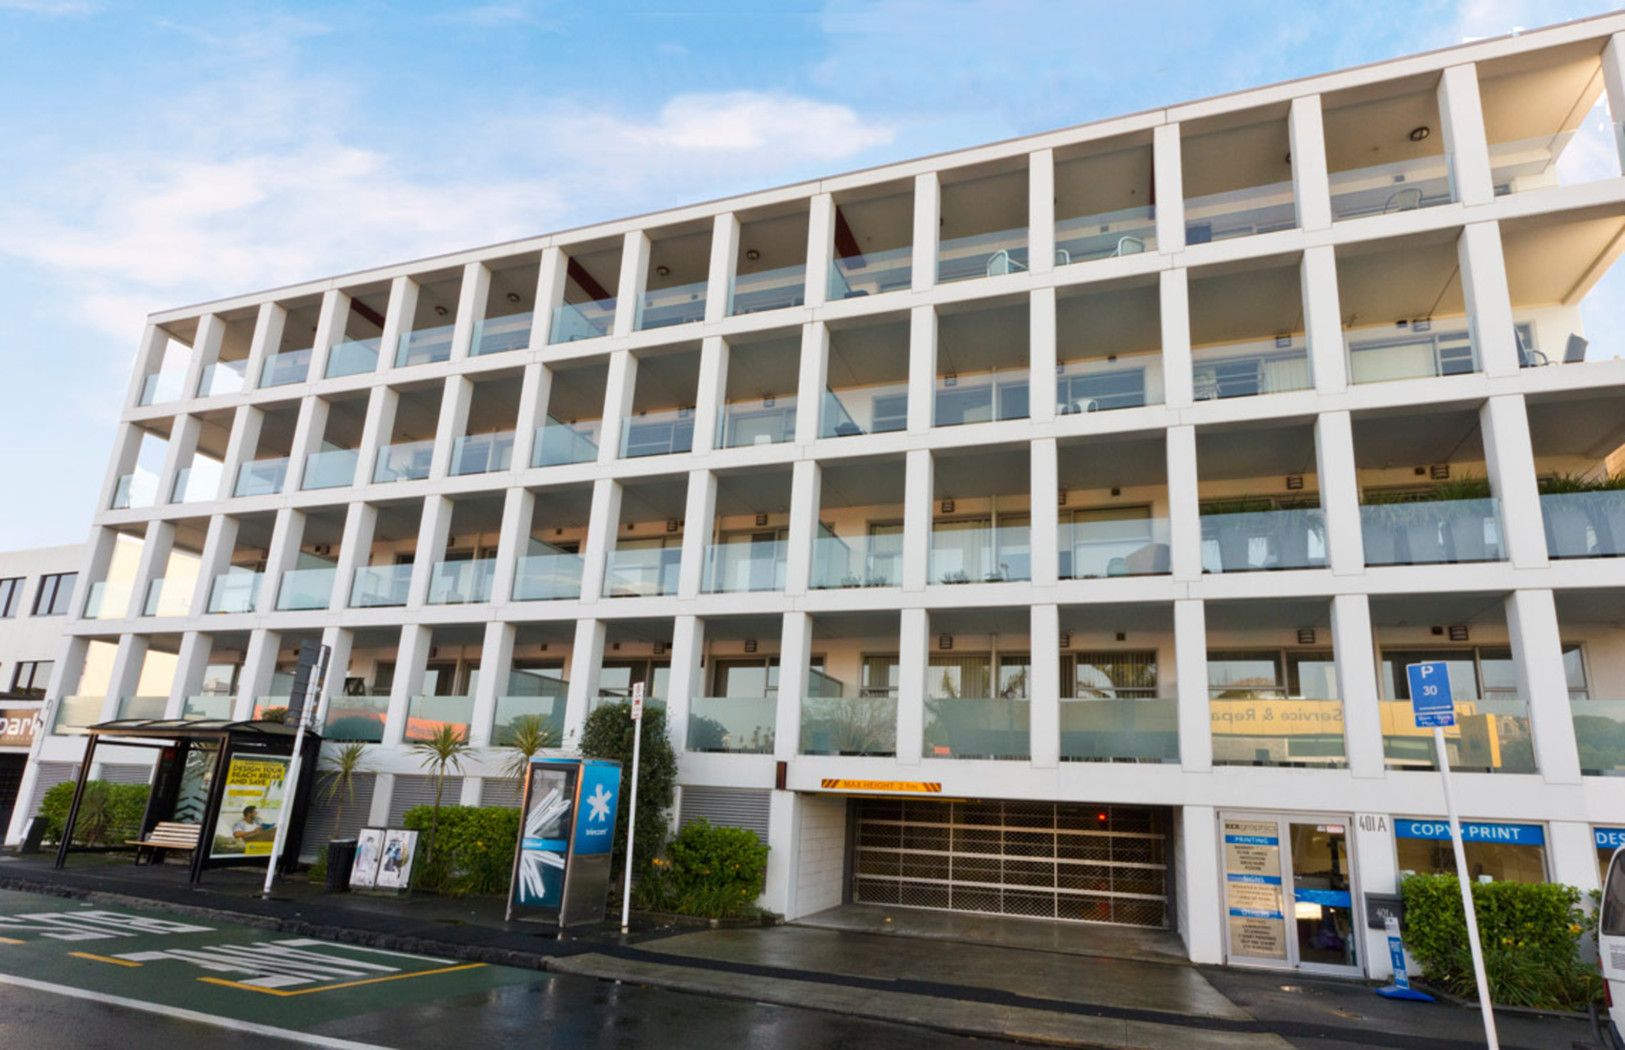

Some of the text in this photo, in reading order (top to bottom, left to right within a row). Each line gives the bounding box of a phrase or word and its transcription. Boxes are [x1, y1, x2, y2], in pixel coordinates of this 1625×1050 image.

[1421, 665, 1433, 678] P
[1423, 685, 1437, 695] 30
[1469, 826, 1520, 840] PRINT
